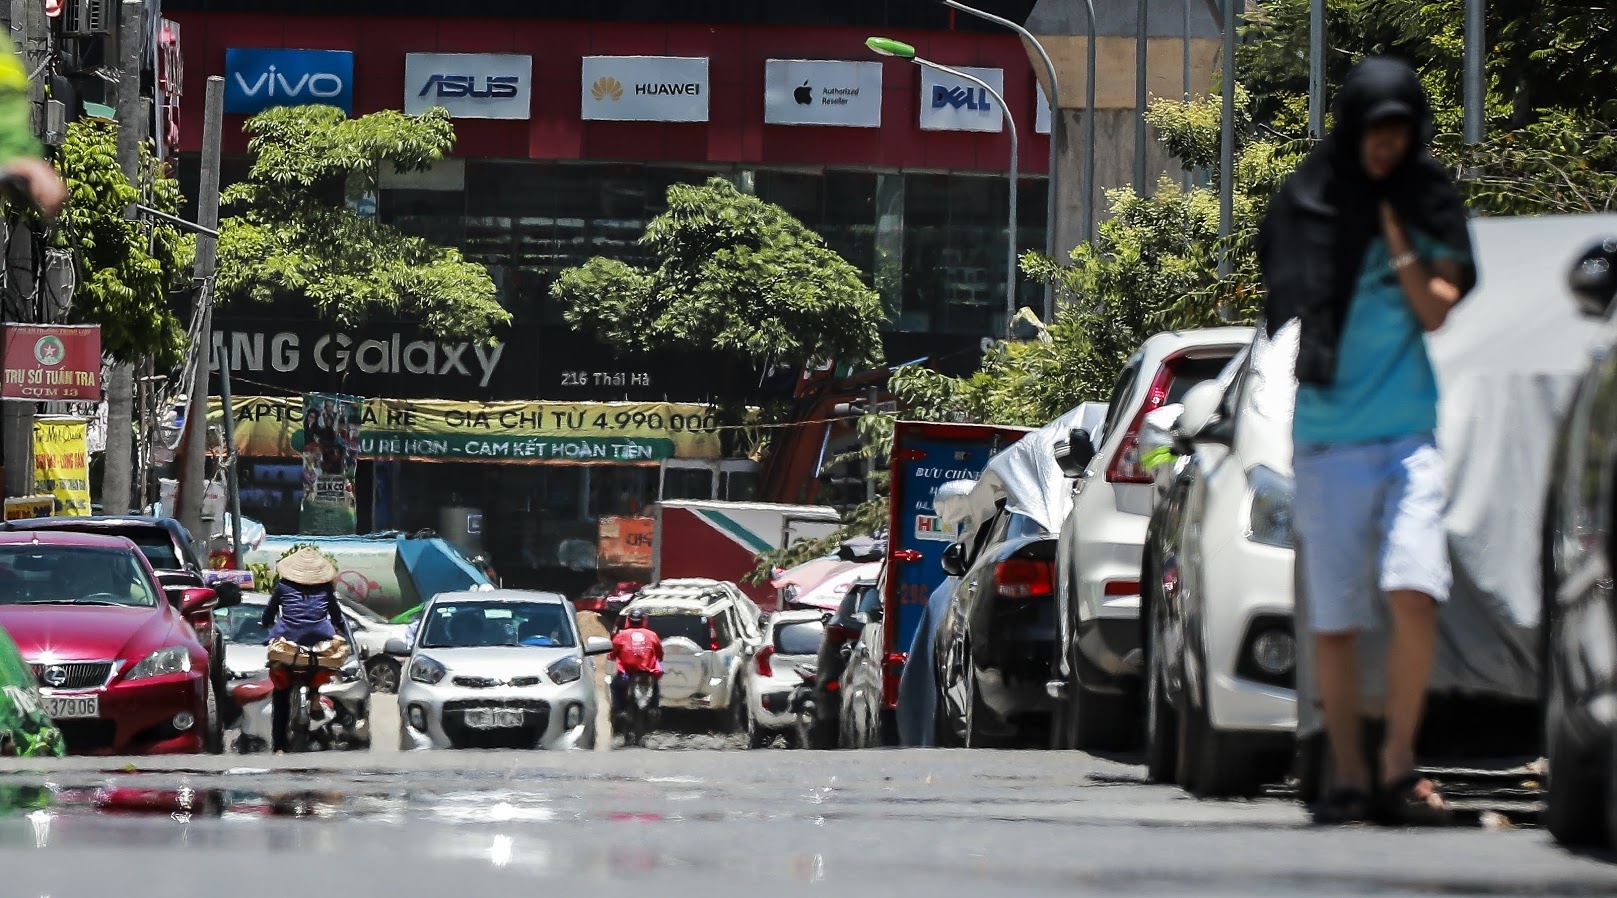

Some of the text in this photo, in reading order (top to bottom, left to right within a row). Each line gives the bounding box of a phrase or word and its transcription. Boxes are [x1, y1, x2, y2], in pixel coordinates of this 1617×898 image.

[235, 64, 343, 98] vivo
[419, 74, 519, 98] ASUS
[635, 83, 700, 95] HUAWEI
[822, 86, 860, 96] Authorized
[821, 97, 849, 106] Reseller
[932, 85, 991, 111] DELL
[313, 332, 505, 387] Galaxy
[5, 369, 25, 387] TRỤ
[28, 364, 44, 385] SỞ
[75, 371, 96, 387] TRA
[561, 372, 588, 386] 216
[22, 387, 79, 398] CỤM 13
[592, 411, 717, 433] 4.990.000
[465, 441, 509, 456] CAM
[513, 438, 548, 456] KẾT
[552, 440, 607, 458] HOÀN
